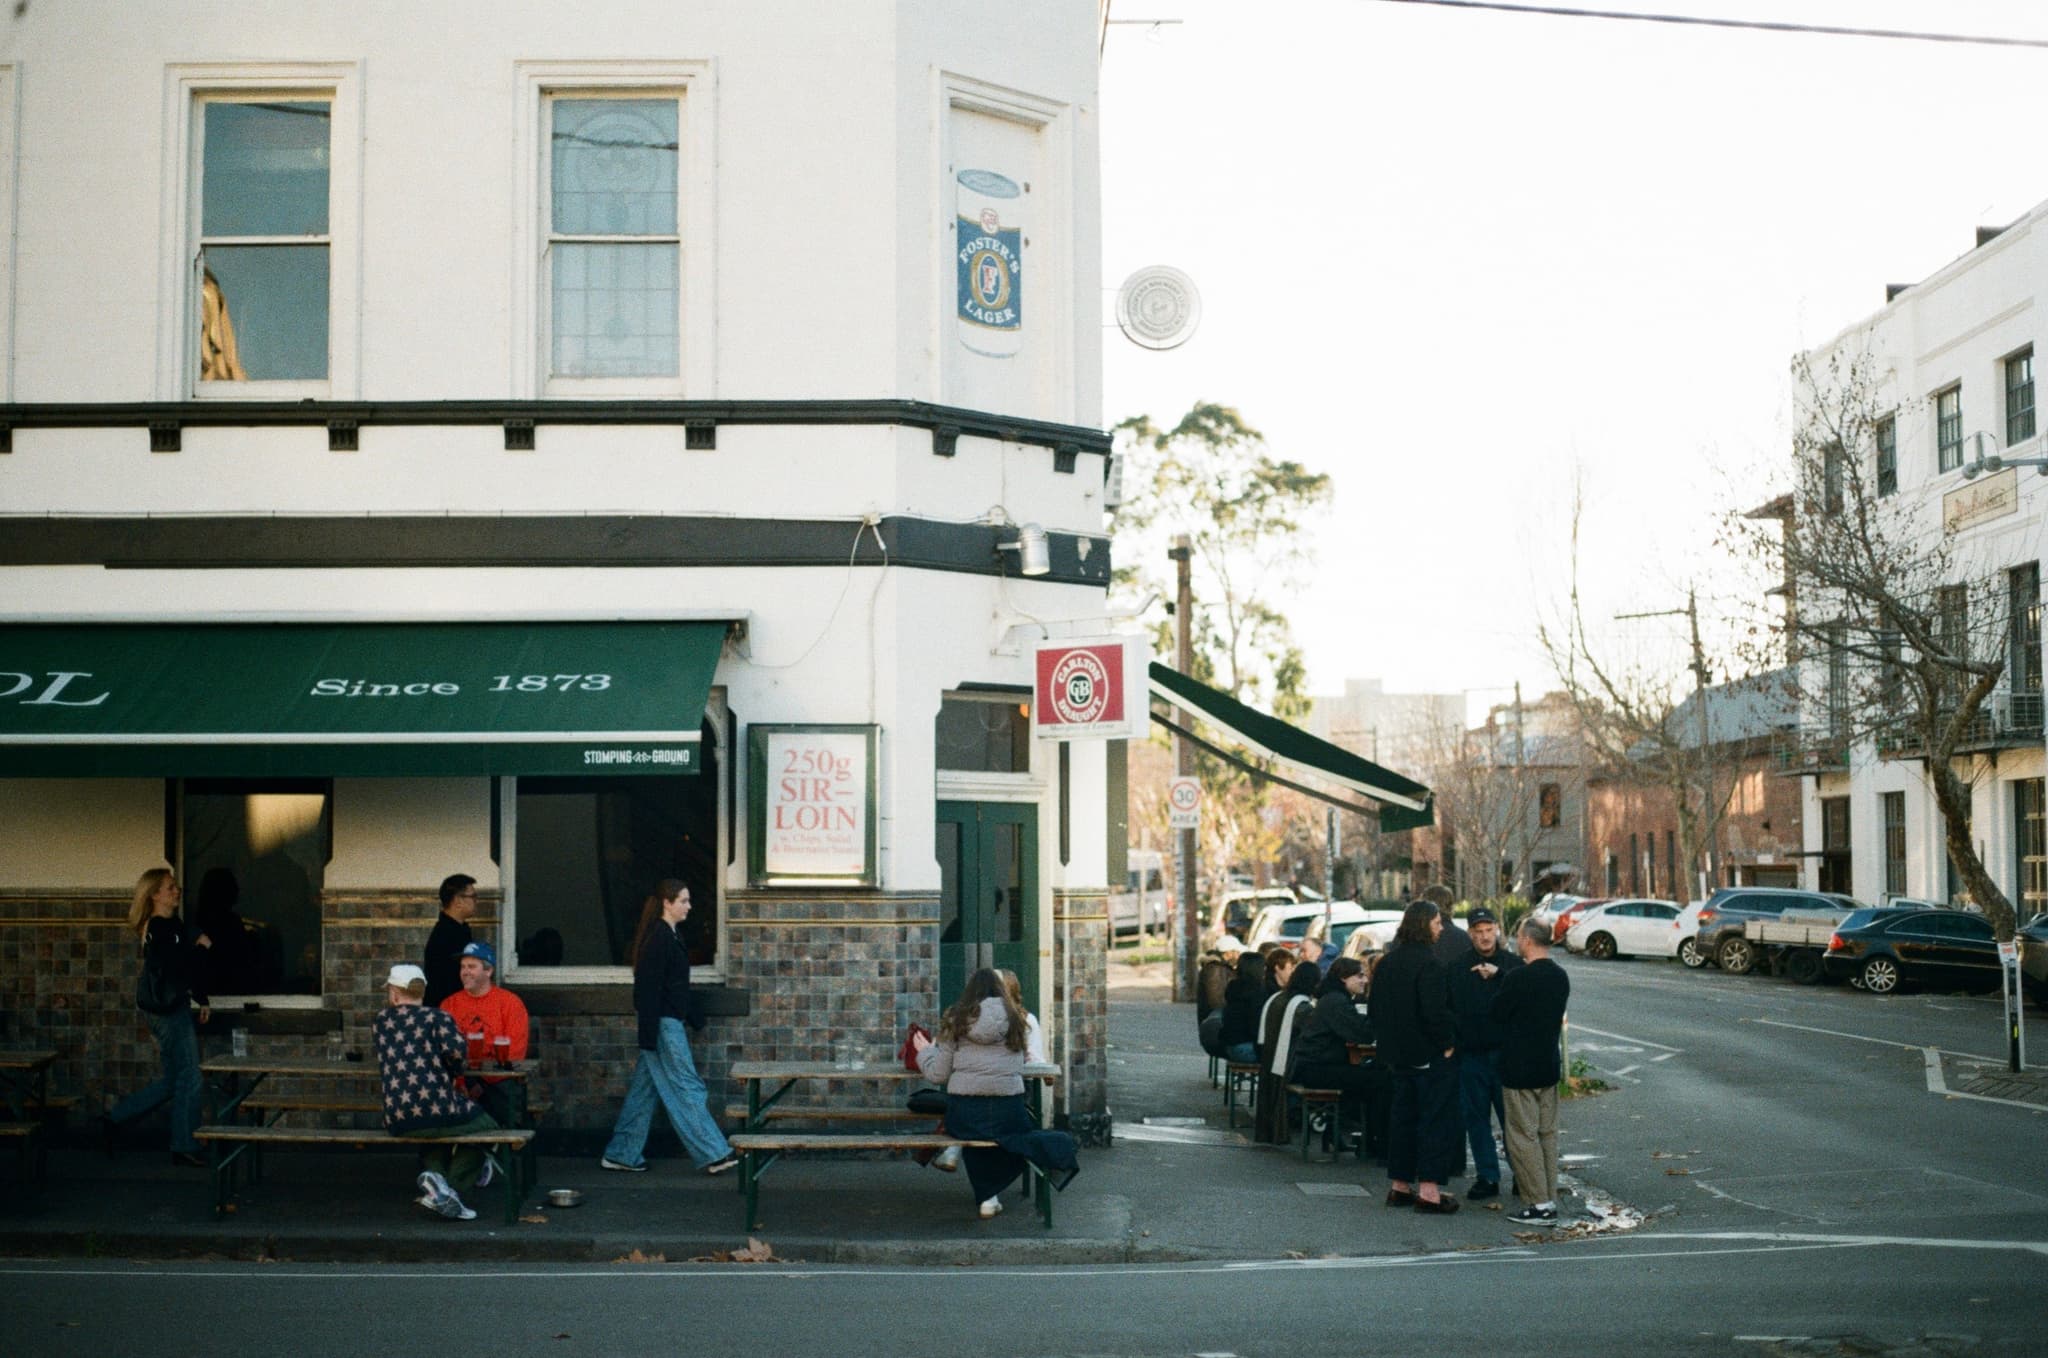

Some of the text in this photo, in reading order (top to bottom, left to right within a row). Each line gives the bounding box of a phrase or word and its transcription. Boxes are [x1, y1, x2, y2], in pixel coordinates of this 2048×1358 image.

[959, 237, 1020, 274] FOSTER'S
[963, 299, 1016, 324] LAGER
[1057, 656, 1103, 683] CARLTON
[310, 674, 612, 697] Since 1873
[1057, 696, 1102, 721] DRAUGHT
[584, 749, 690, 764] STOMPING GROUND
[783, 748, 853, 782] 250g
[1176, 789, 1194, 803] 30
[774, 804, 858, 831] LOIN
